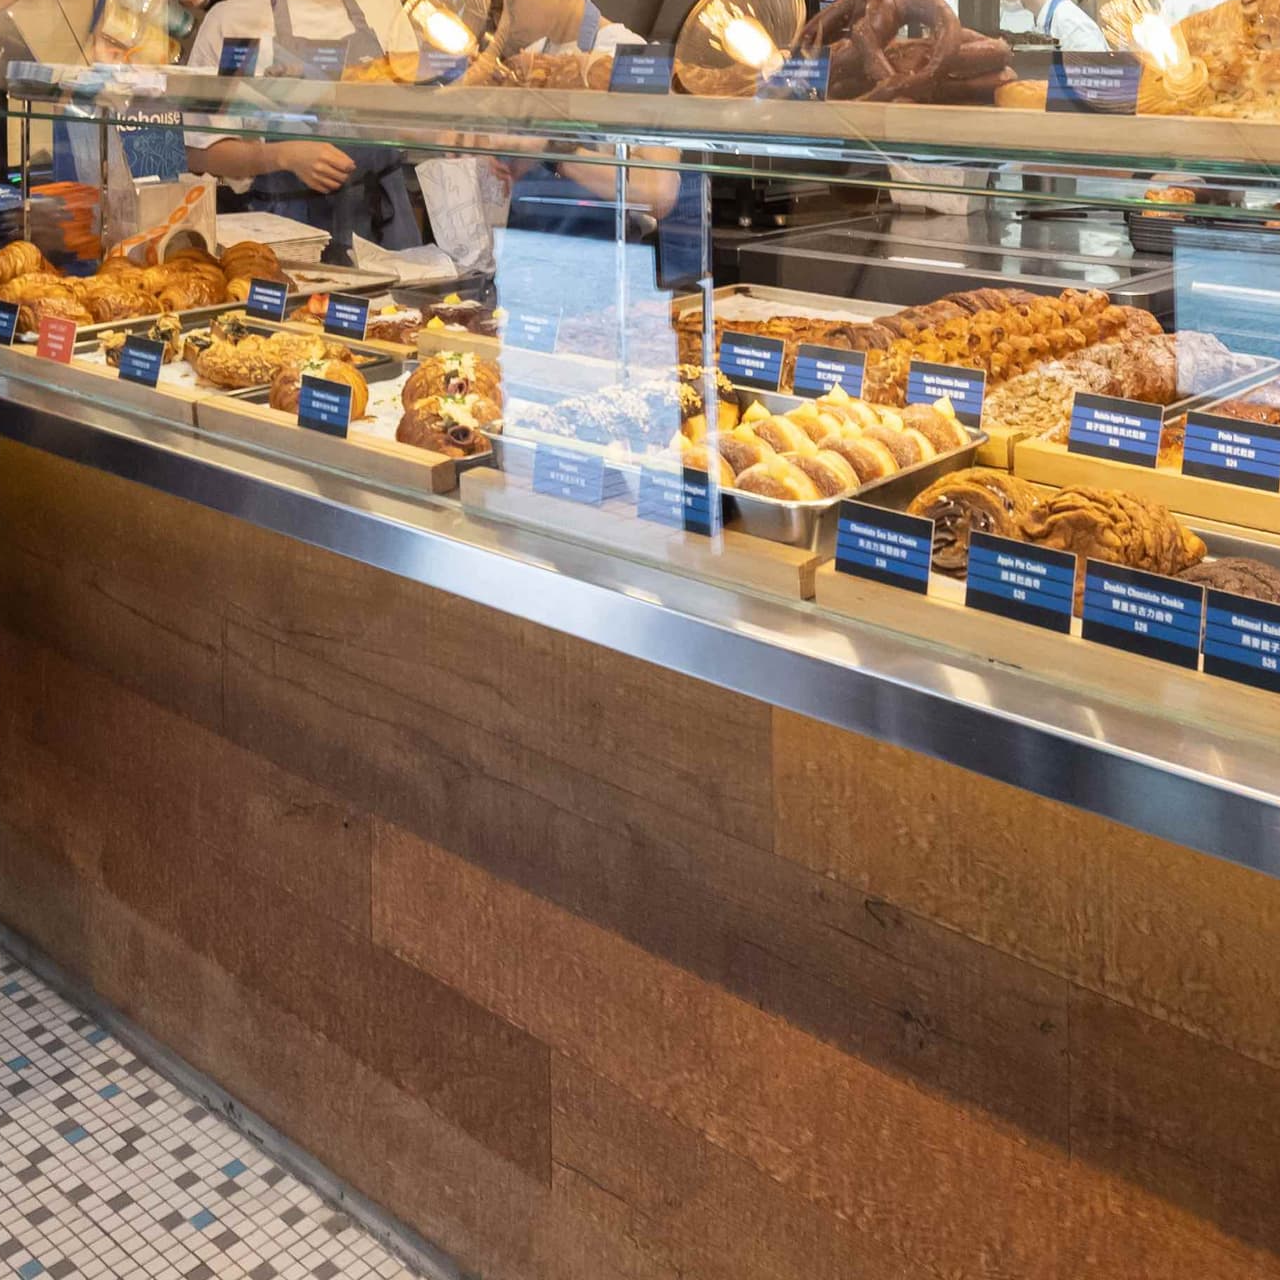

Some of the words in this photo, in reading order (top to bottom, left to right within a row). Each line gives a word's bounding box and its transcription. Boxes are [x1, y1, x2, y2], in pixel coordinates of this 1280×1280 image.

[1218, 431, 1233, 441] Plain
[850, 523, 876, 537] Chocolate
[876, 529, 886, 540] Sea
[887, 531, 899, 543] Salt
[898, 535, 917, 548] Cookie
[997, 554, 1014, 568] Apple
[1015, 559, 1025, 570] Pie
[1025, 561, 1047, 575] Cookie
[1103, 580, 1126, 595] Double
[1127, 586, 1160, 603] Chocolate
[1161, 595, 1184, 610] Cookie
[1231, 615, 1261, 632] Oatmeal
